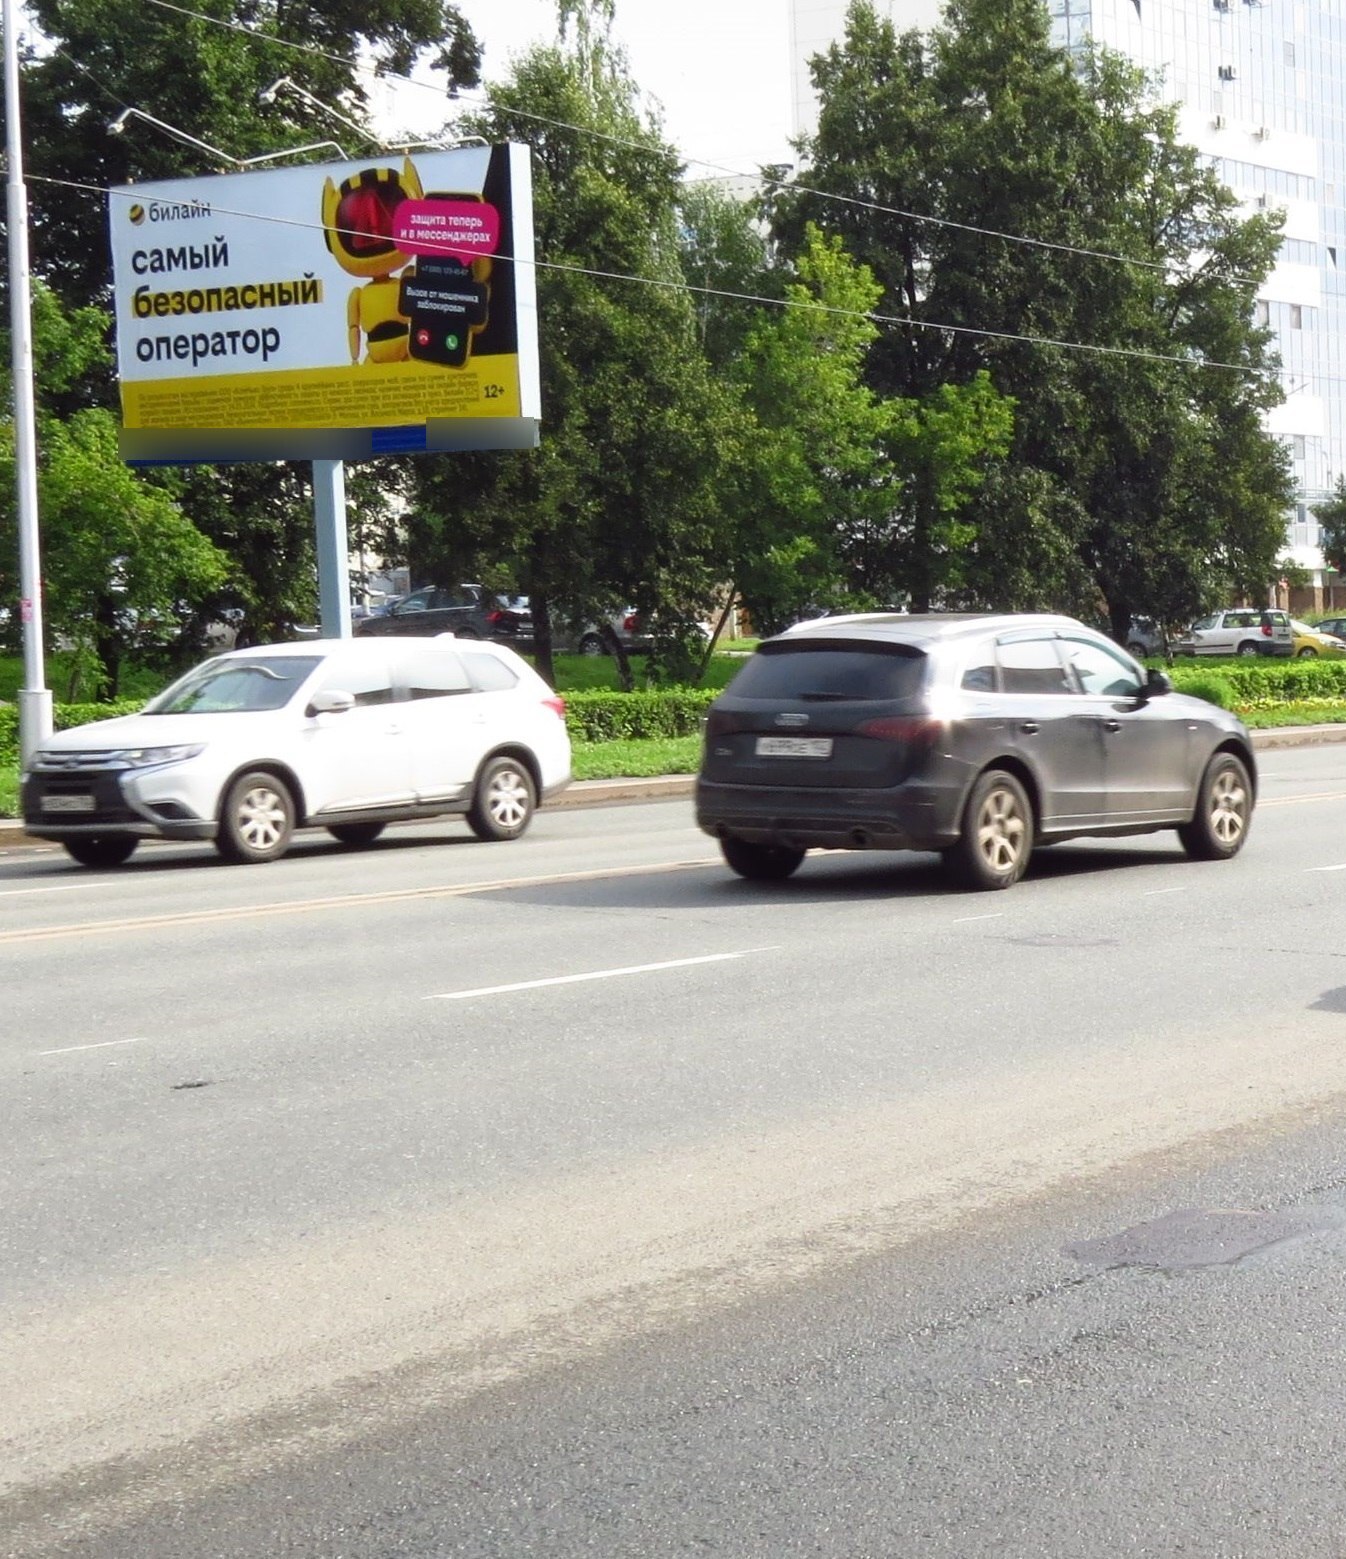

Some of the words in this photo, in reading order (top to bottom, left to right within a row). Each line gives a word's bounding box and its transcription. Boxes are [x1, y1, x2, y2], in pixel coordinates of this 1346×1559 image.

[149, 199, 211, 222] билайн
[410, 214, 446, 227] защита
[448, 216, 483, 229] теперь
[400, 229, 407, 239] и
[409, 229, 415, 239] в
[416, 229, 491, 245] мессенджерах
[132, 235, 229, 275] самый
[134, 272, 319, 319] безопасный
[136, 327, 281, 368] оператор
[484, 384, 505, 399] 12+
